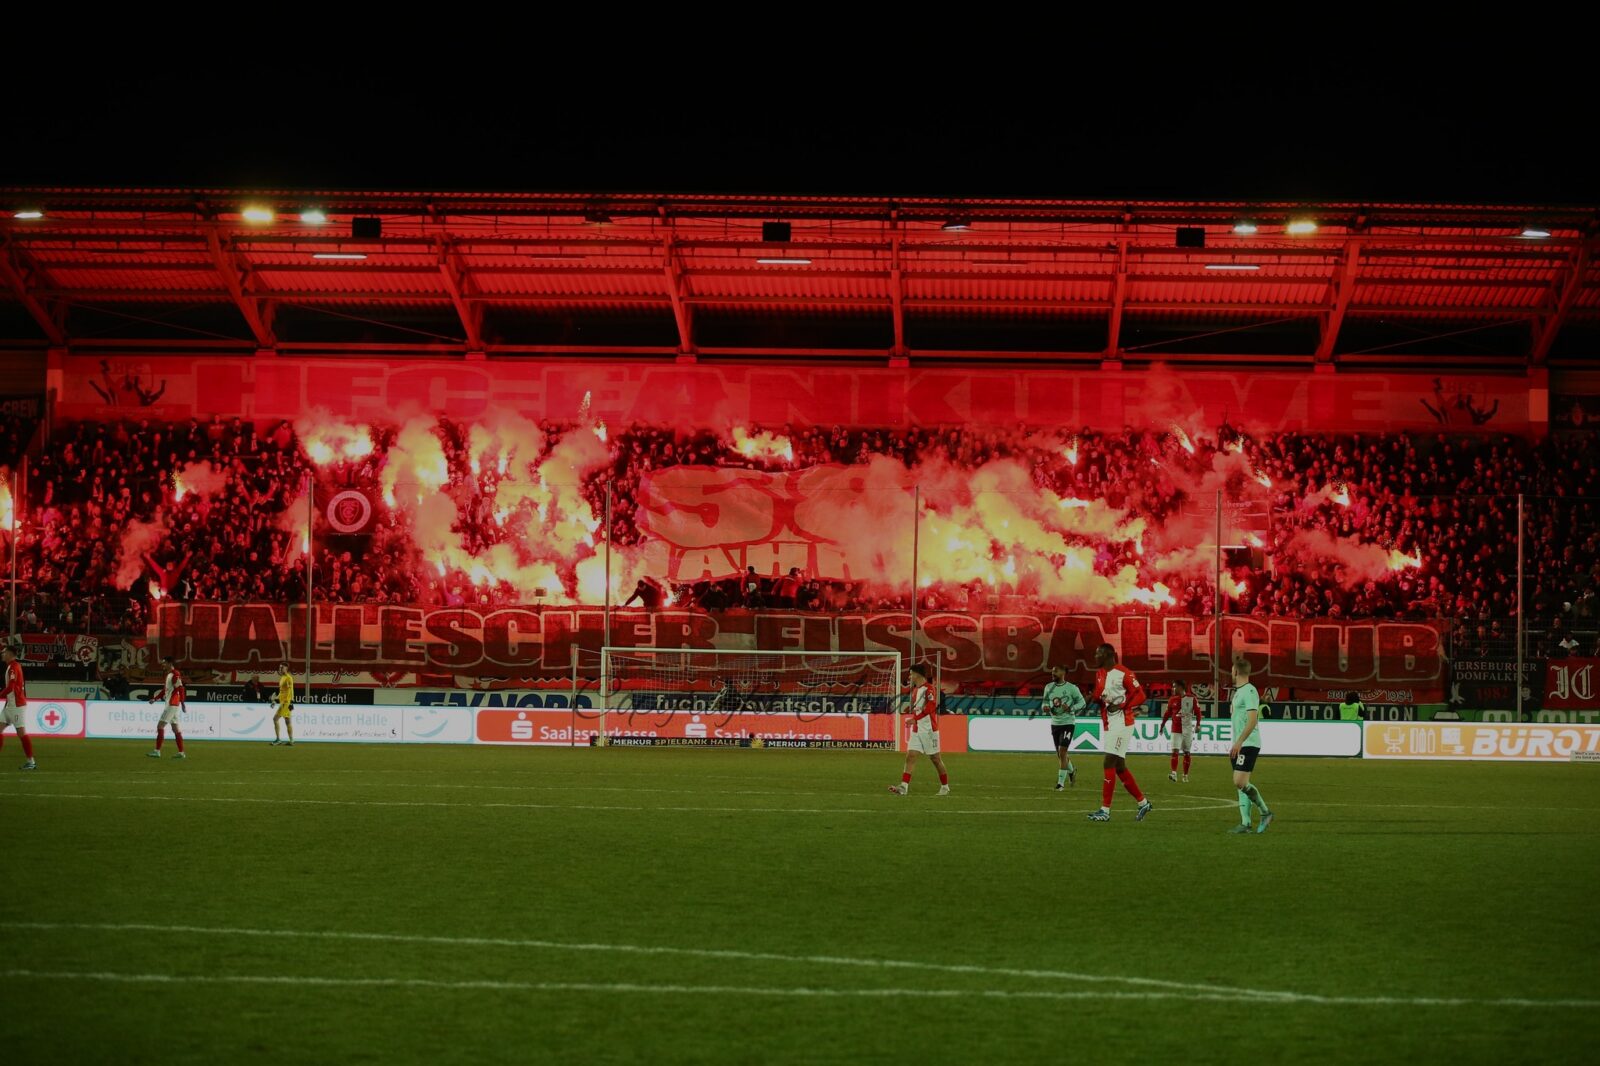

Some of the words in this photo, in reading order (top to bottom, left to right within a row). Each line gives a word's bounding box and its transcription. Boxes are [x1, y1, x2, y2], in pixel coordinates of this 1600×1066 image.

[156, 603, 719, 670] HALLESCHER
[321, 693, 347, 704] dich!
[1282, 704, 1414, 721] AUTOTION
[321, 713, 352, 725] team
[613, 738, 652, 746] MERKUR
[655, 738, 708, 746] SPIELBANK
[710, 738, 741, 746] HALLE
[768, 740, 807, 748] MERKUR
[810, 741, 863, 749] SPIELBANK
[865, 741, 895, 750] HALLE
